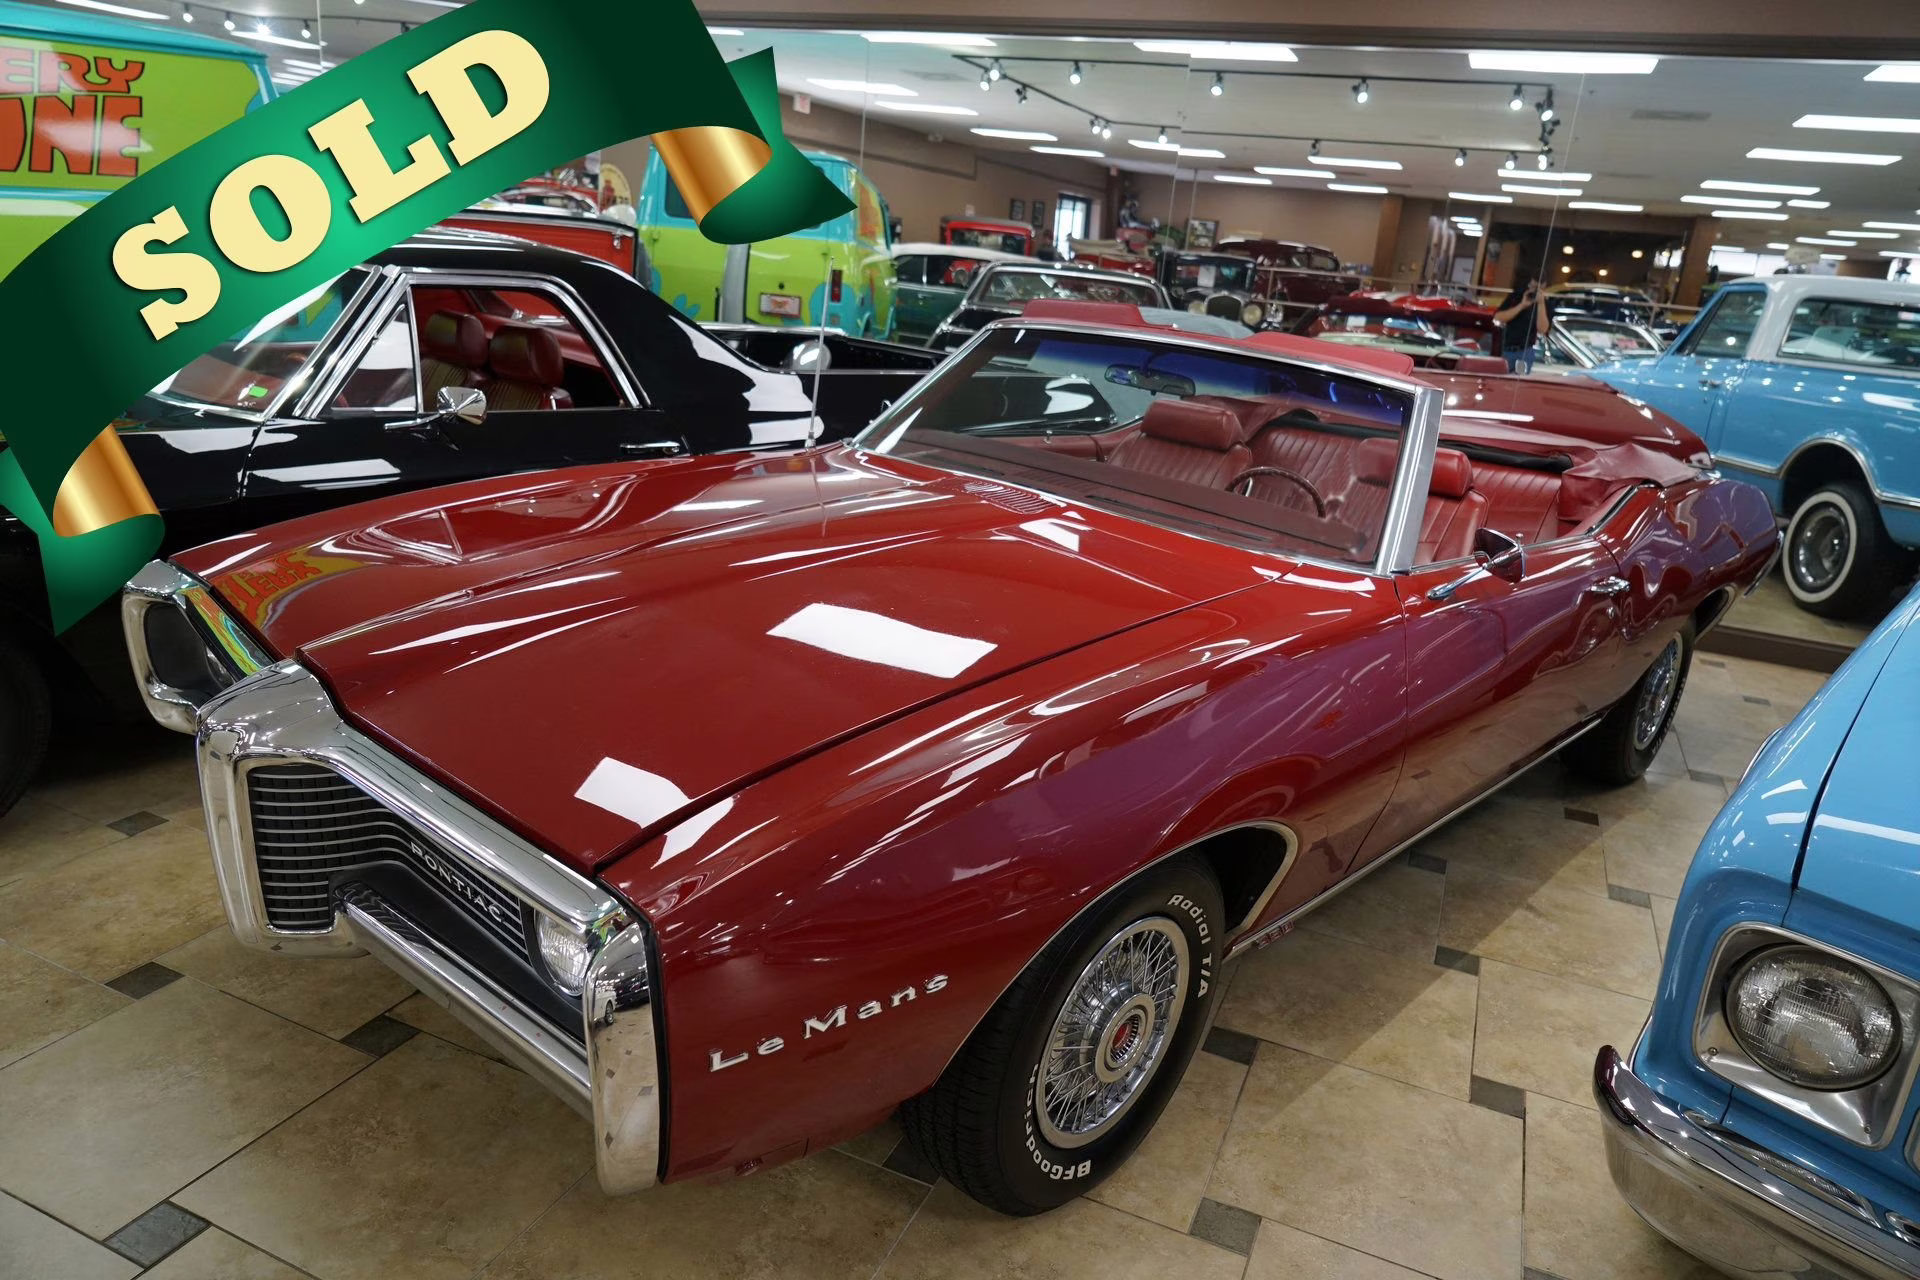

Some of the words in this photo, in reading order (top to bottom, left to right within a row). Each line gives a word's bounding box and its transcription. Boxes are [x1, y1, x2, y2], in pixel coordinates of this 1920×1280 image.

[410, 841, 503, 923] PONTIAC
[1168, 894, 1212, 945] Radial
[1197, 953, 1212, 998] T/A
[708, 1034, 785, 1072] Le
[802, 973, 949, 1041] Mans
